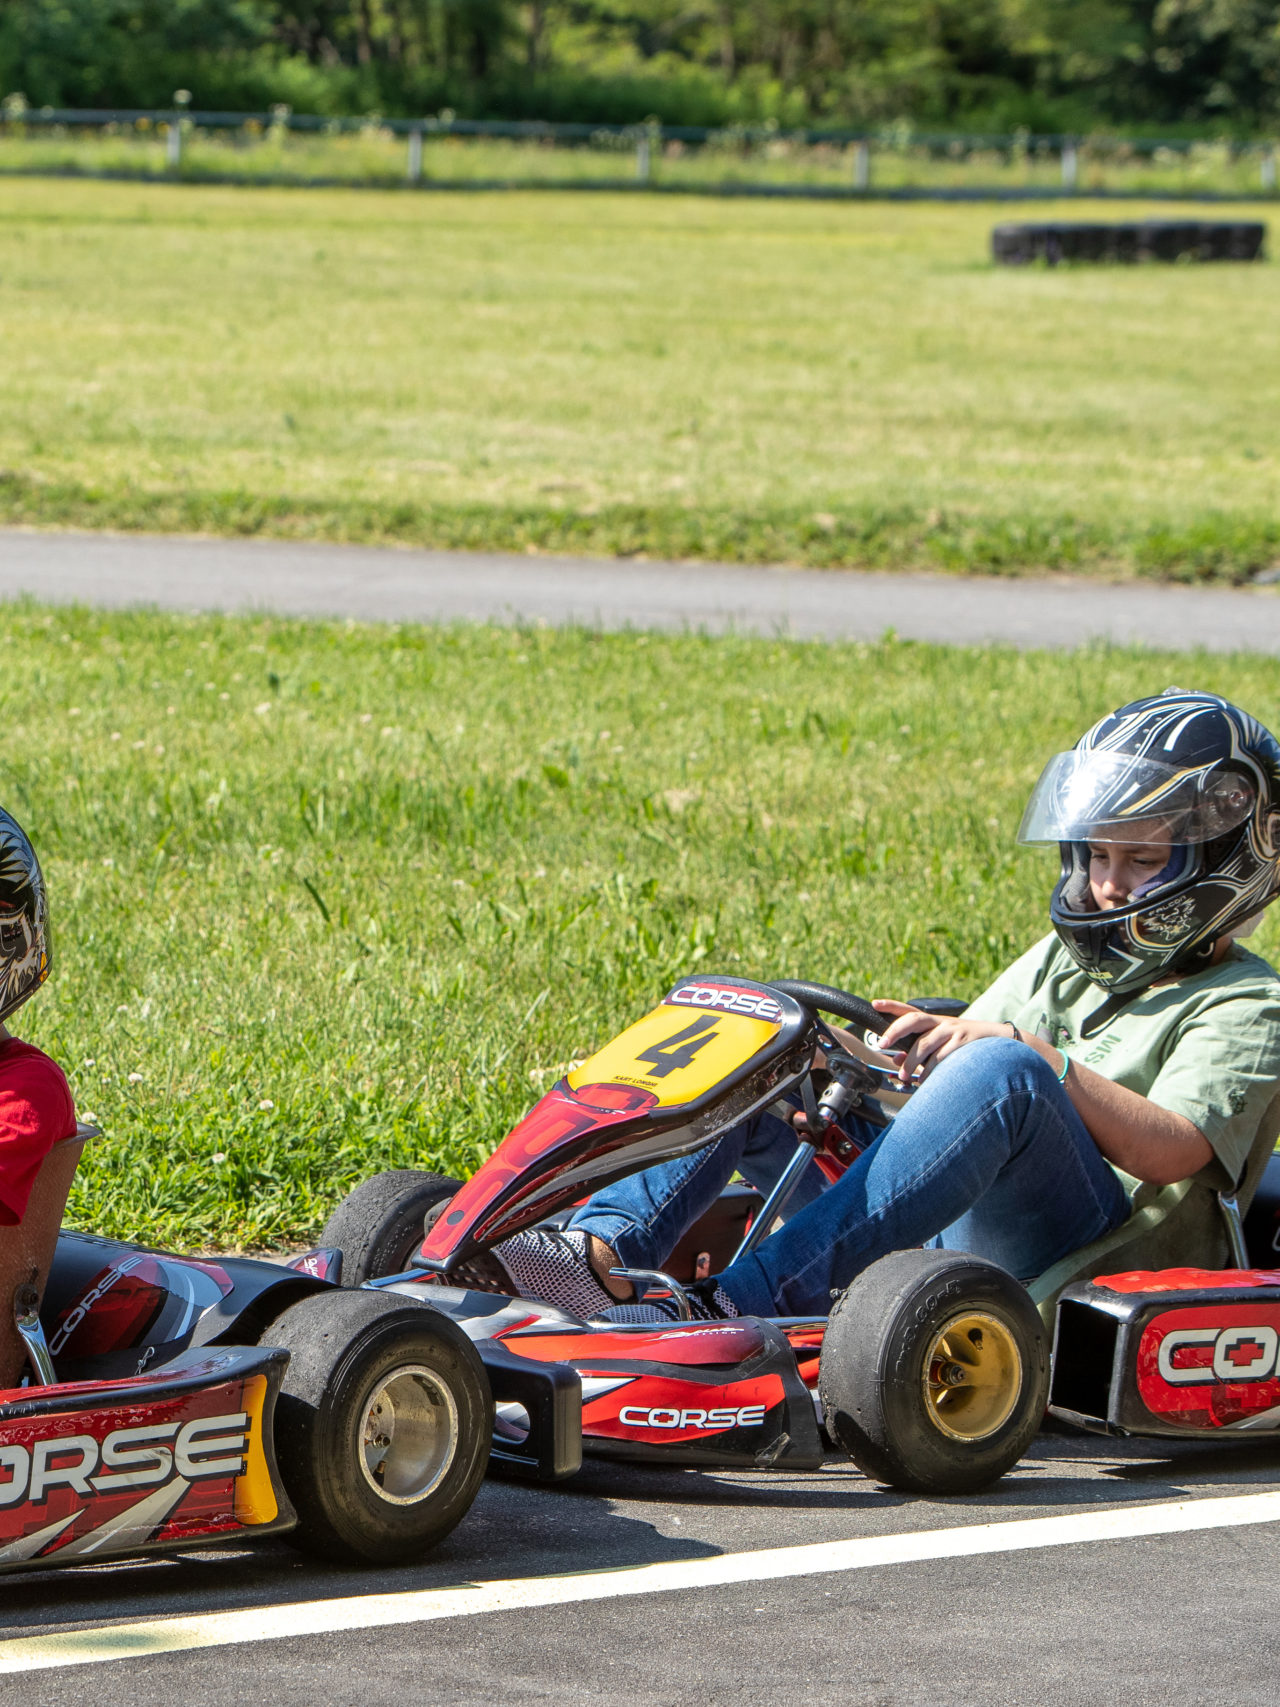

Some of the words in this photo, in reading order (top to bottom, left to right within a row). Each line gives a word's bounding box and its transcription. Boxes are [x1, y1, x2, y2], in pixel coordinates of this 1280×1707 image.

[671, 986, 782, 1017] CORSE
[635, 1014, 722, 1078] 4
[49, 1256, 144, 1356] CORSE
[1158, 1326, 1280, 1382] CO
[619, 1404, 766, 1429] CORSE
